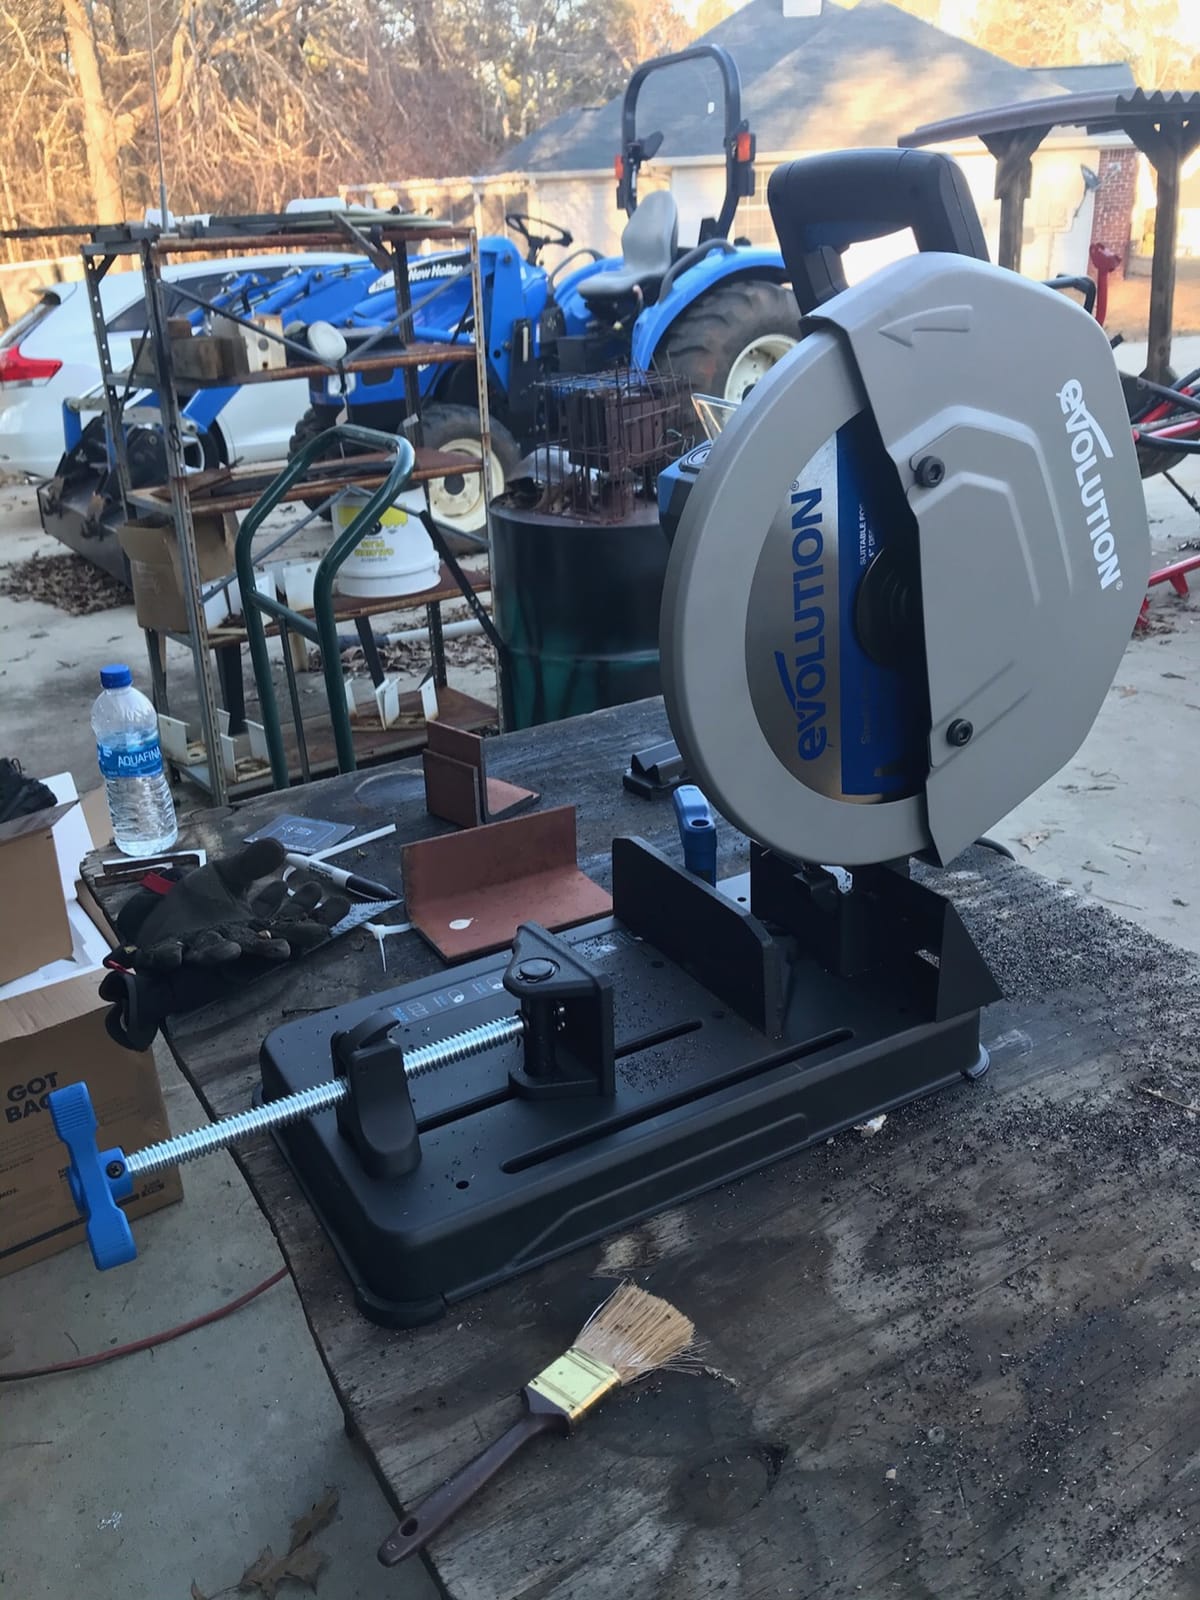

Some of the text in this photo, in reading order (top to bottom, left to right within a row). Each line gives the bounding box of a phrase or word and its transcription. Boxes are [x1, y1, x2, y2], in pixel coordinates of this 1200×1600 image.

[408, 262, 463, 282] New Hollan
[7, 1071, 58, 1102] GOT
